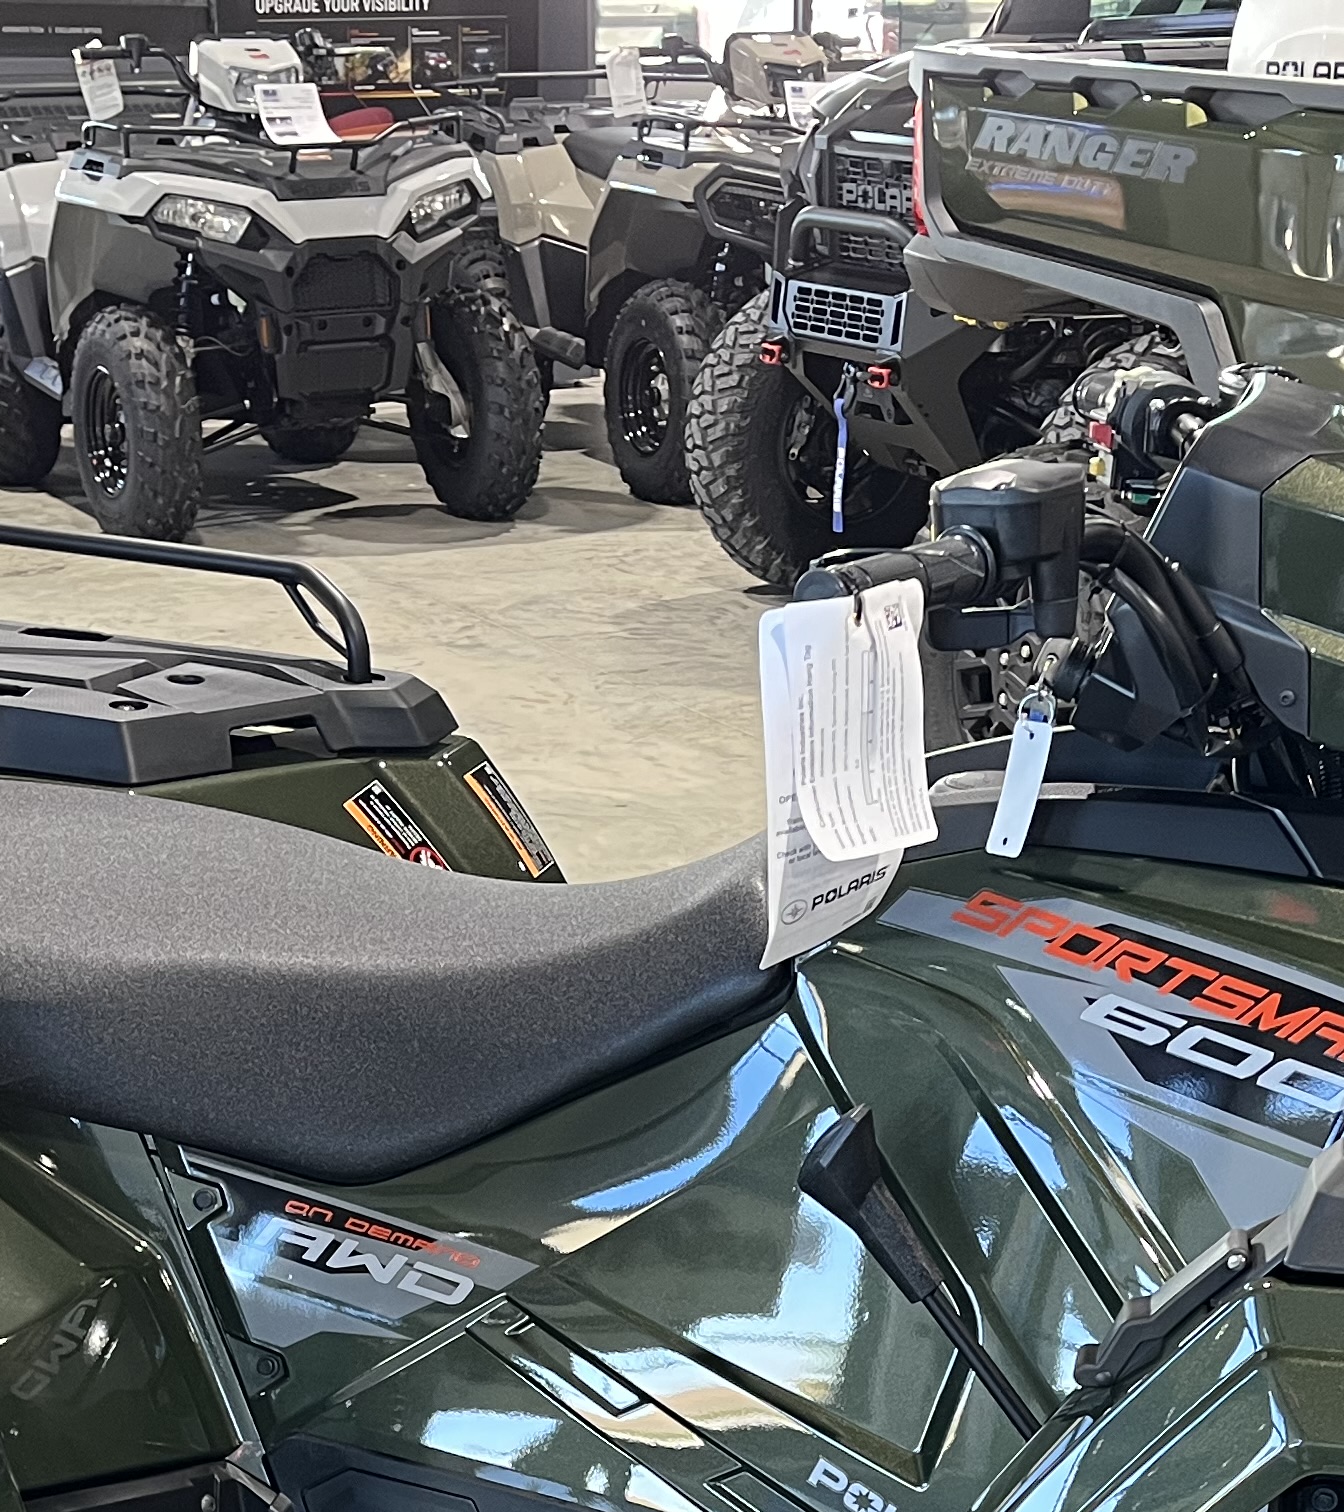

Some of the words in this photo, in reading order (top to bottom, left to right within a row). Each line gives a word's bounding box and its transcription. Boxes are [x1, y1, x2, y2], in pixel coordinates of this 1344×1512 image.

[255, 0, 320, 14] UPGRADE
[323, 0, 363, 13] YOUR
[363, 0, 430, 12] VISIBILITY
[964, 158, 1058, 187] EXTREME
[1060, 171, 1117, 198] DUTY
[972, 112, 1198, 185] RANGER
[811, 864, 892, 911] POLARIS
[256, 1216, 476, 1306] AWD
[283, 1198, 333, 1223] ON
[343, 1215, 482, 1270] DEMAND
